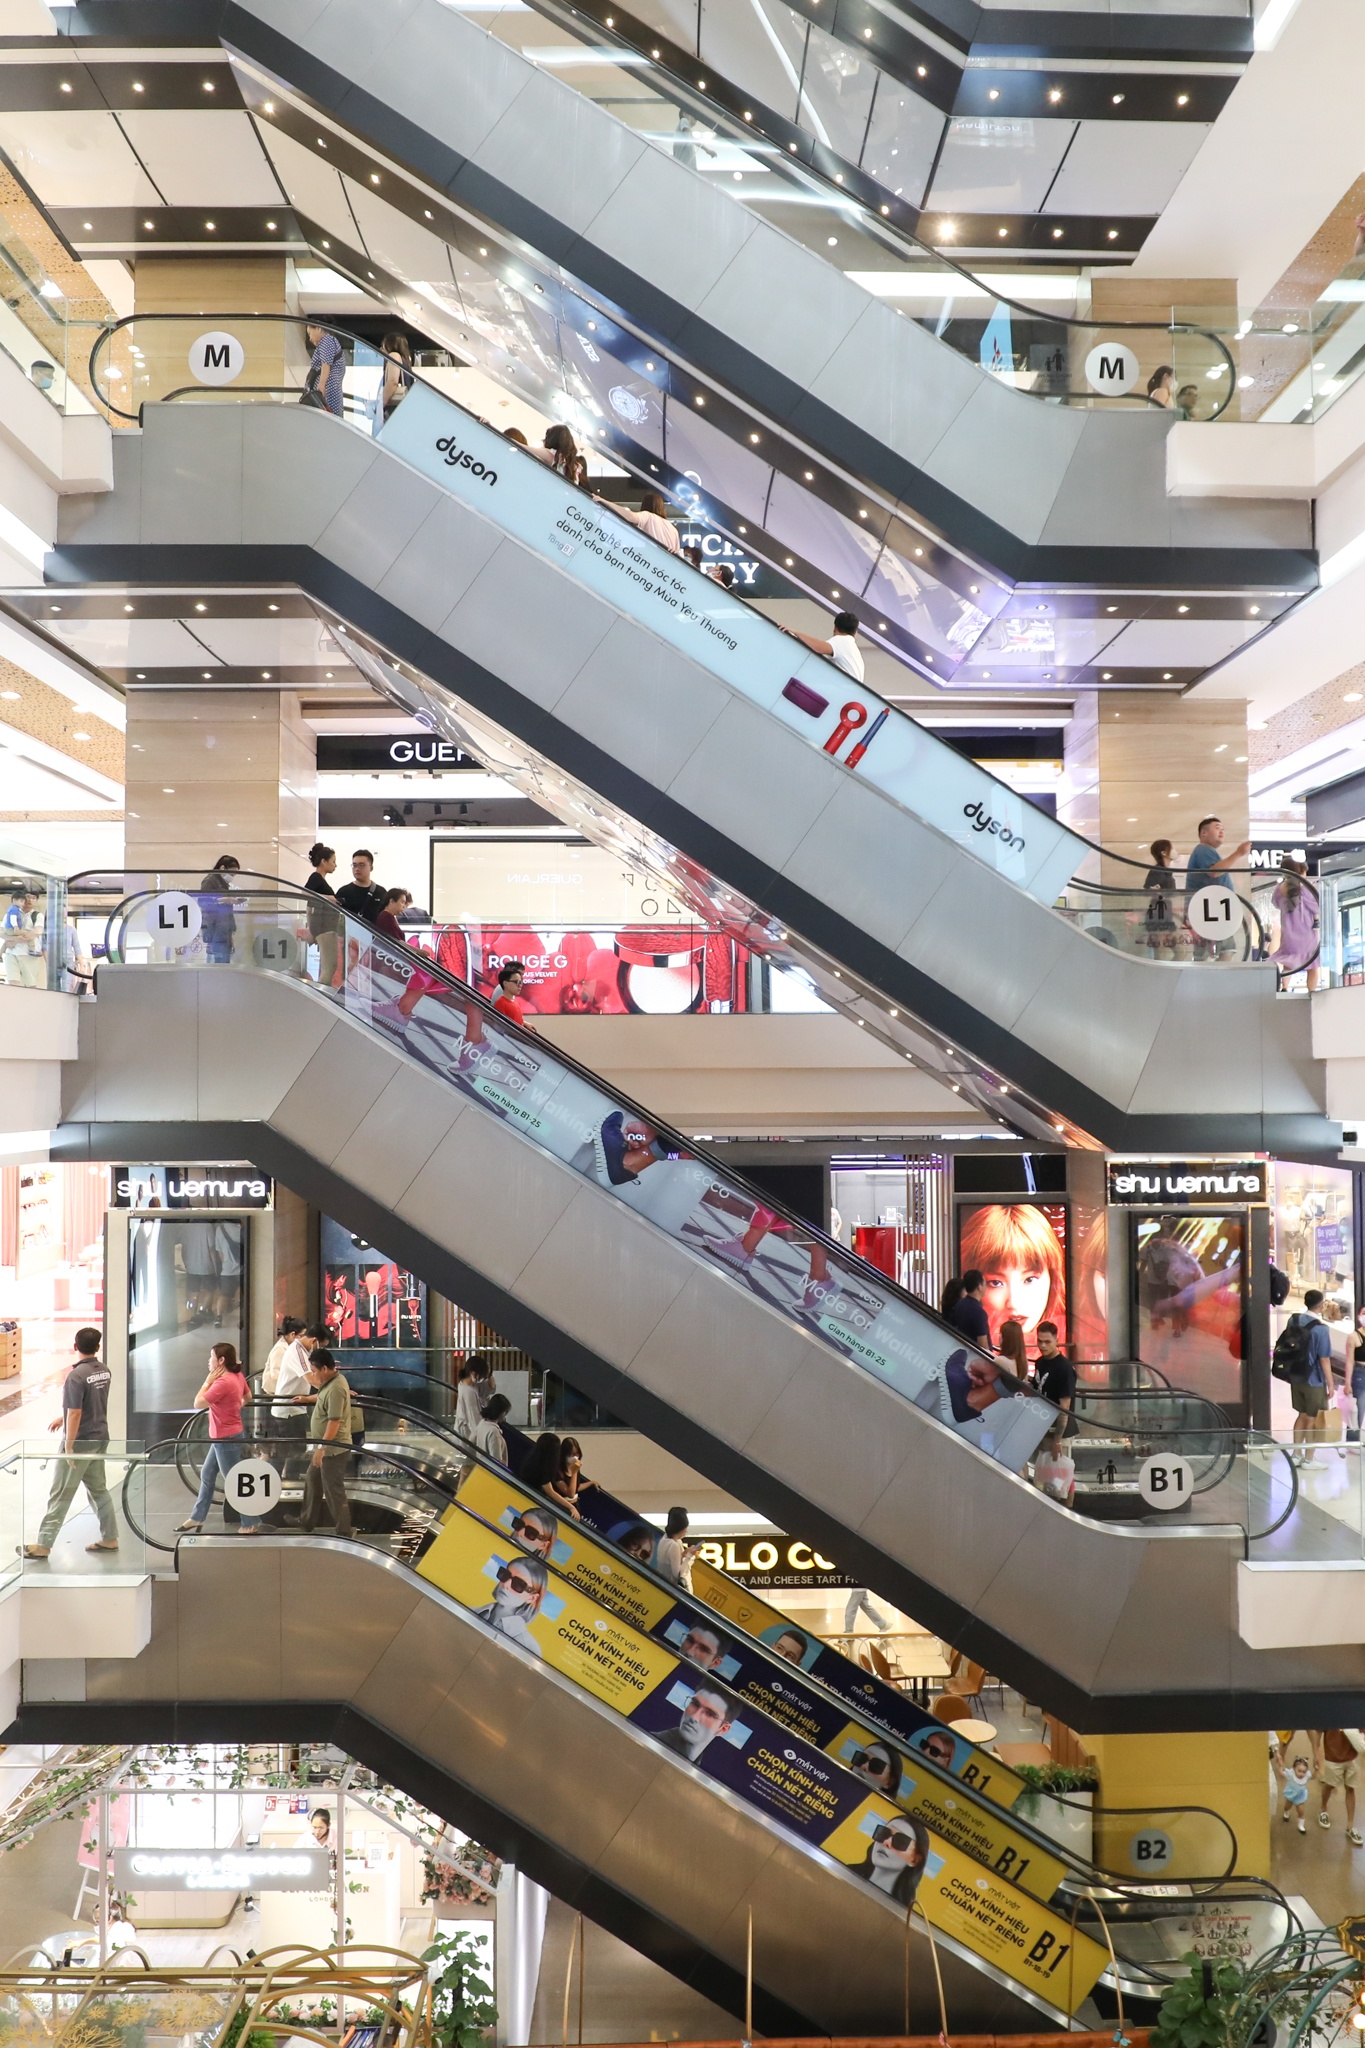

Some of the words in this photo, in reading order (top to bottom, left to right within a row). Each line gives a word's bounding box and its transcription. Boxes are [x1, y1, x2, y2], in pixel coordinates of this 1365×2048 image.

[203, 344, 230, 368] M
[1099, 356, 1125, 381] M
[435, 436, 498, 486] dyson
[566, 505, 594, 531] Công
[594, 527, 622, 549] nghệ
[622, 545, 651, 570] chăm
[651, 565, 670, 582] sóc
[670, 577, 687, 594] tóc
[556, 519, 583, 542] dành
[584, 538, 603, 555] cho
[603, 550, 625, 571] bạn
[625, 567, 654, 591] trong
[654, 586, 679, 608] Mùa
[680, 601, 699, 621] Yêu
[699, 616, 738, 650] Thương
[963, 801, 1026, 853] dyson
[158, 905, 189, 929] L1
[1203, 898, 1231, 922] L1
[262, 939, 288, 959] L1
[375, 948, 412, 978] ecco
[553, 954, 568, 969] G
[452, 1034, 502, 1076] Made
[504, 1072, 529, 1094] for
[530, 1086, 596, 1144] Walking
[483, 1085, 500, 1103] Gian
[500, 1095, 520, 1115] hàng
[520, 1110, 542, 1128] B1-25
[117, 1178, 162, 1198] shu
[168, 1180, 266, 1198] uemura
[693, 1170, 730, 1199] ecco
[1115, 1174, 1161, 1193] shu
[1166, 1175, 1260, 1194] uemura
[798, 1273, 847, 1314] Made
[849, 1308, 874, 1330] for
[875, 1324, 939, 1381] Walking
[828, 1322, 846, 1340] Gian
[846, 1333, 866, 1352] hàng
[865, 1348, 887, 1366] B1-25
[1014, 1391, 1050, 1420] ecco
[237, 1473, 271, 1497] B1
[1150, 1467, 1184, 1492] B1
[699, 1542, 779, 1571] BLO
[577, 1563, 604, 1586] CHỌN
[603, 1582, 626, 1601] KÍNH
[627, 1599, 650, 1617] HIỆU
[750, 1576, 771, 1585] AND
[774, 1576, 814, 1585] CHEESE
[817, 1575, 842, 1584] TART
[558, 1627, 595, 1656] CHUẨN
[594, 1651, 615, 1669] NÉT
[614, 1665, 646, 1691] RIÊNG
[569, 1619, 599, 1643] CHỌN
[599, 1639, 625, 1660] KÍNH
[624, 1657, 650, 1677] HIỆU
[748, 1681, 776, 1703] CHỌN
[775, 1698, 799, 1719] KÍNH
[798, 1715, 821, 1733] HIỆU
[747, 1757, 784, 1785] CHUẨN
[783, 1778, 805, 1798] NÉT
[803, 1793, 835, 1819] RIÊNG
[758, 1748, 789, 1770] CHỌN
[789, 1765, 814, 1787] KÍNH
[813, 1784, 839, 1805] HIỆU
[912, 1807, 945, 1832] CHUẨN
[944, 1827, 963, 1843] NÉT
[962, 1840, 990, 1863] RIÊNG
[921, 1799, 947, 1821] CHỌN
[949, 1815, 972, 1835] KÍNH
[972, 1831, 994, 1850] HIỆU
[995, 1846, 1031, 1882] B1
[1137, 1839, 1167, 1860] B2
[940, 1887, 975, 1914] CHUẨN
[975, 1907, 996, 1928] NÉT
[995, 1921, 1025, 1948] RIÊNG
[950, 1878, 980, 1903] CHỌN
[980, 1896, 1005, 1919] KÍNH
[1005, 1916, 1030, 1935] HIỆU
[1023, 1958, 1051, 1979] B1-18-19
[1028, 1930, 1070, 1973] B1
